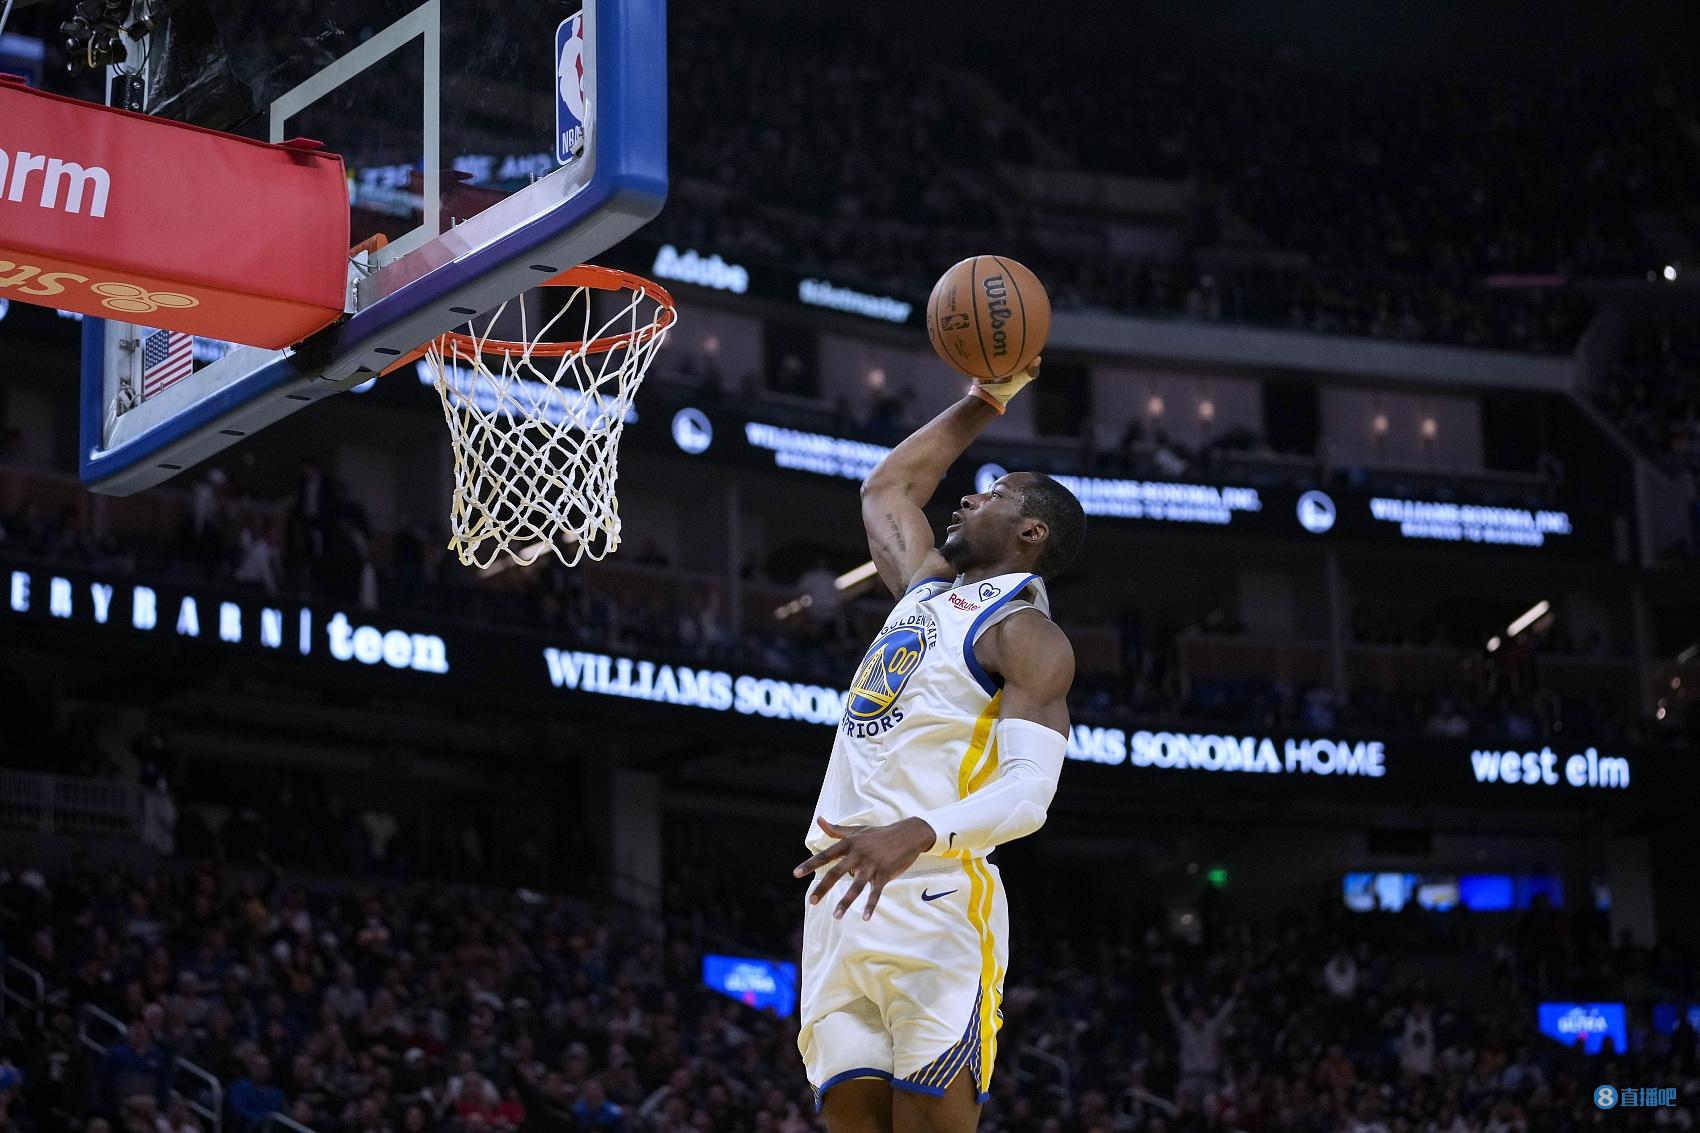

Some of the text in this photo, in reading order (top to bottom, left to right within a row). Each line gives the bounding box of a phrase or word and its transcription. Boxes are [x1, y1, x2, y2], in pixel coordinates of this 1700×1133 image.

[983, 273, 1012, 357] Wilson
[880, 614, 926, 635] GOLDEN
[948, 592, 979, 612] Rakute
[327, 611, 449, 674] teen
[888, 647, 917, 675] 00
[543, 647, 733, 711] WILLIAMS
[1130, 730, 1283, 773] SONOMA
[1285, 738, 1386, 777] HOME
[1471, 746, 1630, 789] west elm
